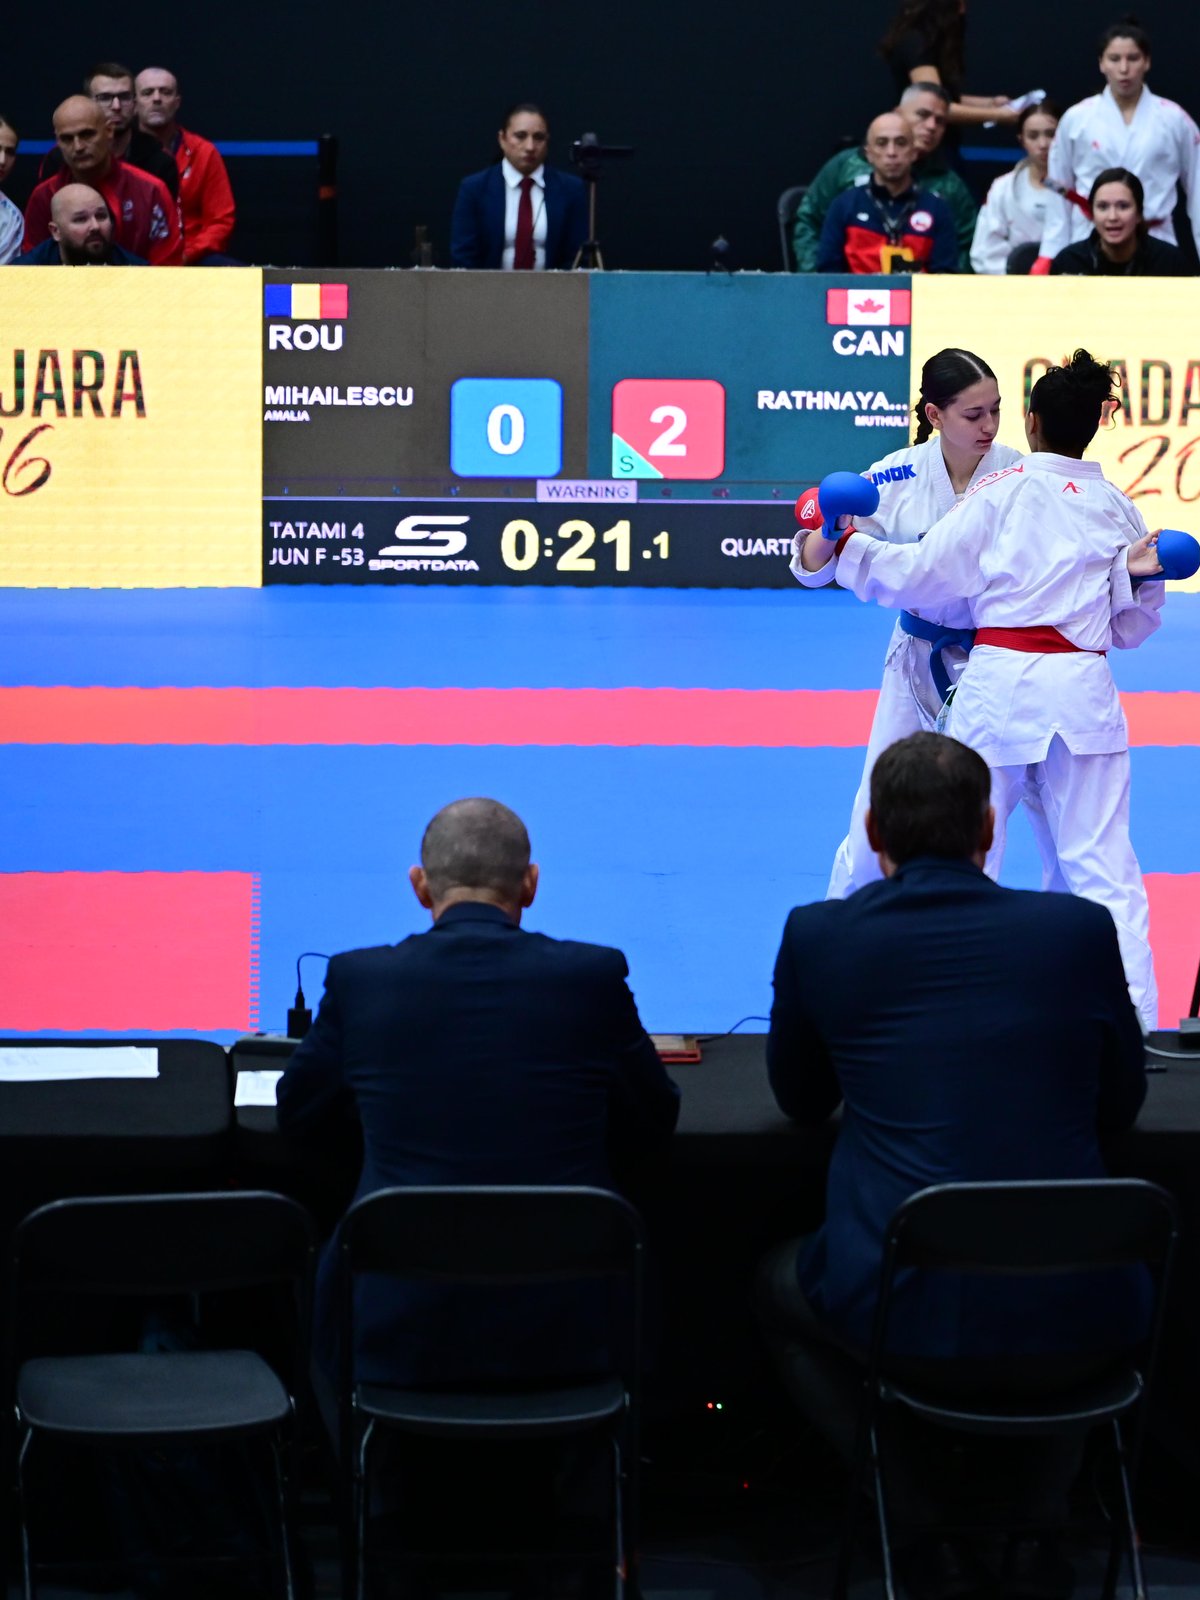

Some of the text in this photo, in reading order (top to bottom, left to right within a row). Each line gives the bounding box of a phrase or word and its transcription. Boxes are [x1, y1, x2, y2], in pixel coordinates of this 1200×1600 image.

[269, 324, 343, 351] ROU
[832, 330, 904, 356] CAN
[265, 386, 413, 406] MIHAILESCU
[264, 410, 310, 422] AMALIA
[486, 404, 525, 456] 0
[648, 405, 688, 457] 2
[619, 455, 635, 473] S
[546, 485, 629, 499] WARNING
[269, 521, 364, 539] TATAMI 4
[269, 548, 364, 566] JUN F -53
[368, 559, 479, 571] SPORTDATA
